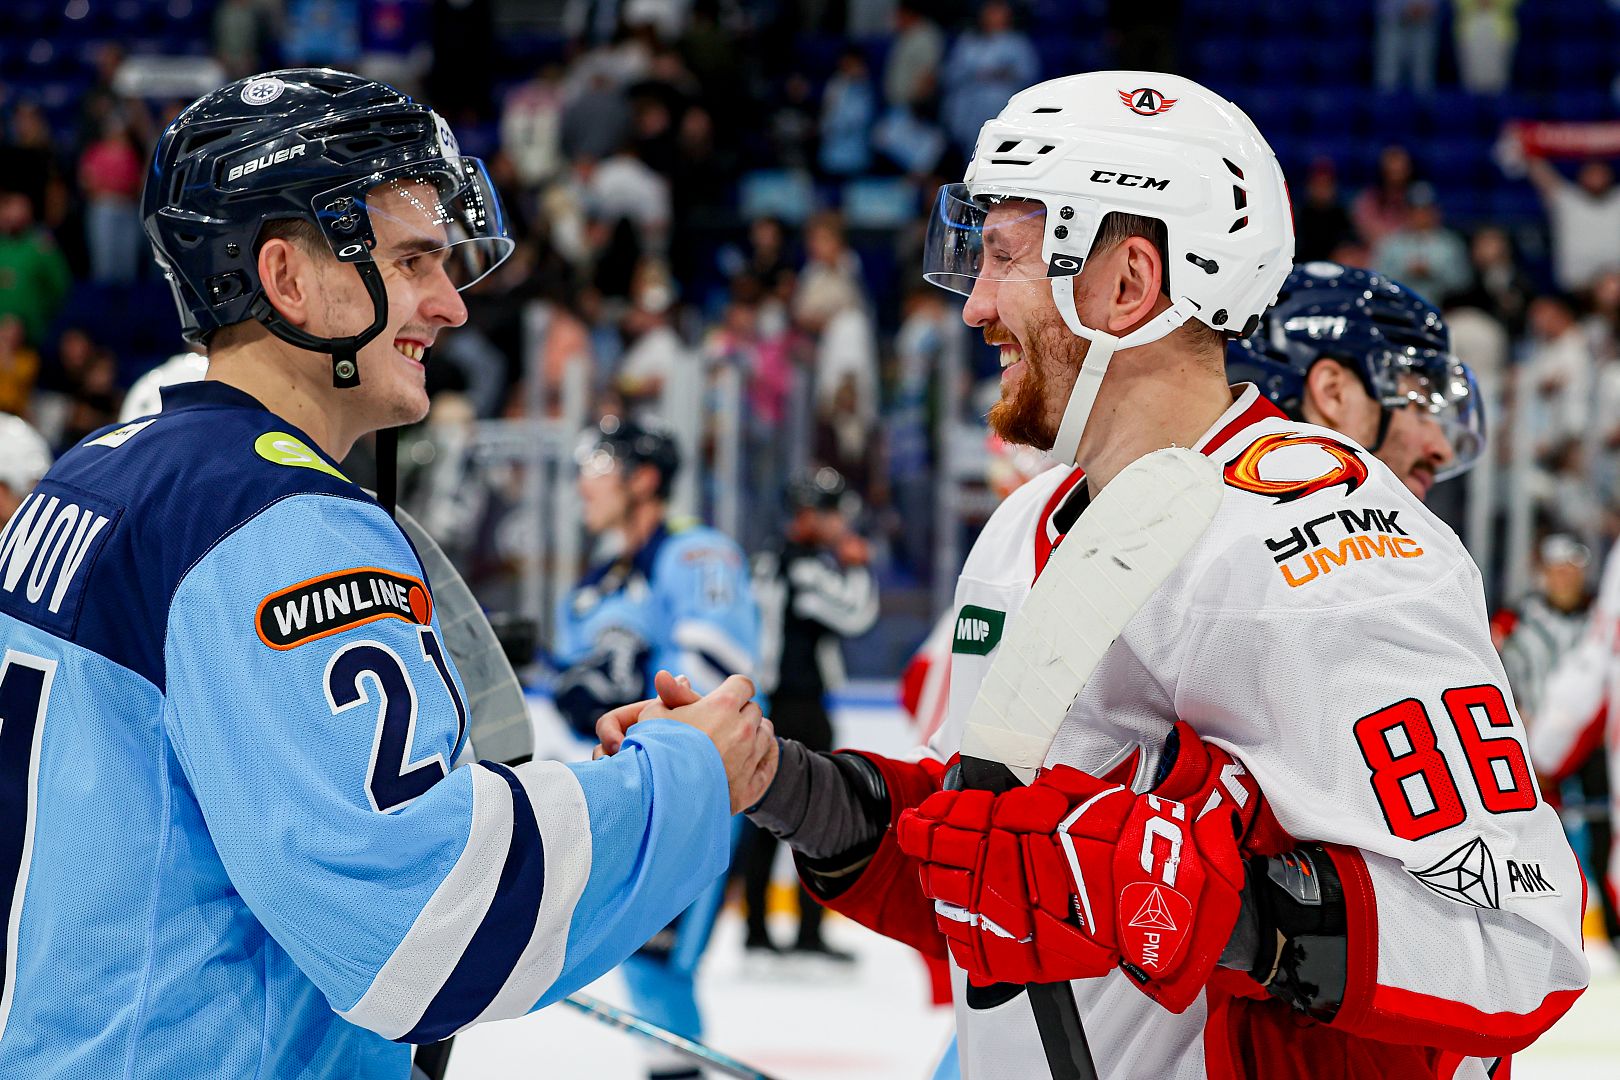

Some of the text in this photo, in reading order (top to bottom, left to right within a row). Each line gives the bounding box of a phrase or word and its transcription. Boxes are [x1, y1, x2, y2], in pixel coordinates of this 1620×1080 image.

[228, 144, 306, 182] BAUER
[1089, 169, 1171, 191] CCM
[1264, 508, 1409, 564] УГМК
[1280, 535, 1424, 588] UMMC
[273, 578, 411, 637] WINLINE
[323, 625, 467, 815] 21
[1353, 684, 1538, 842] 86
